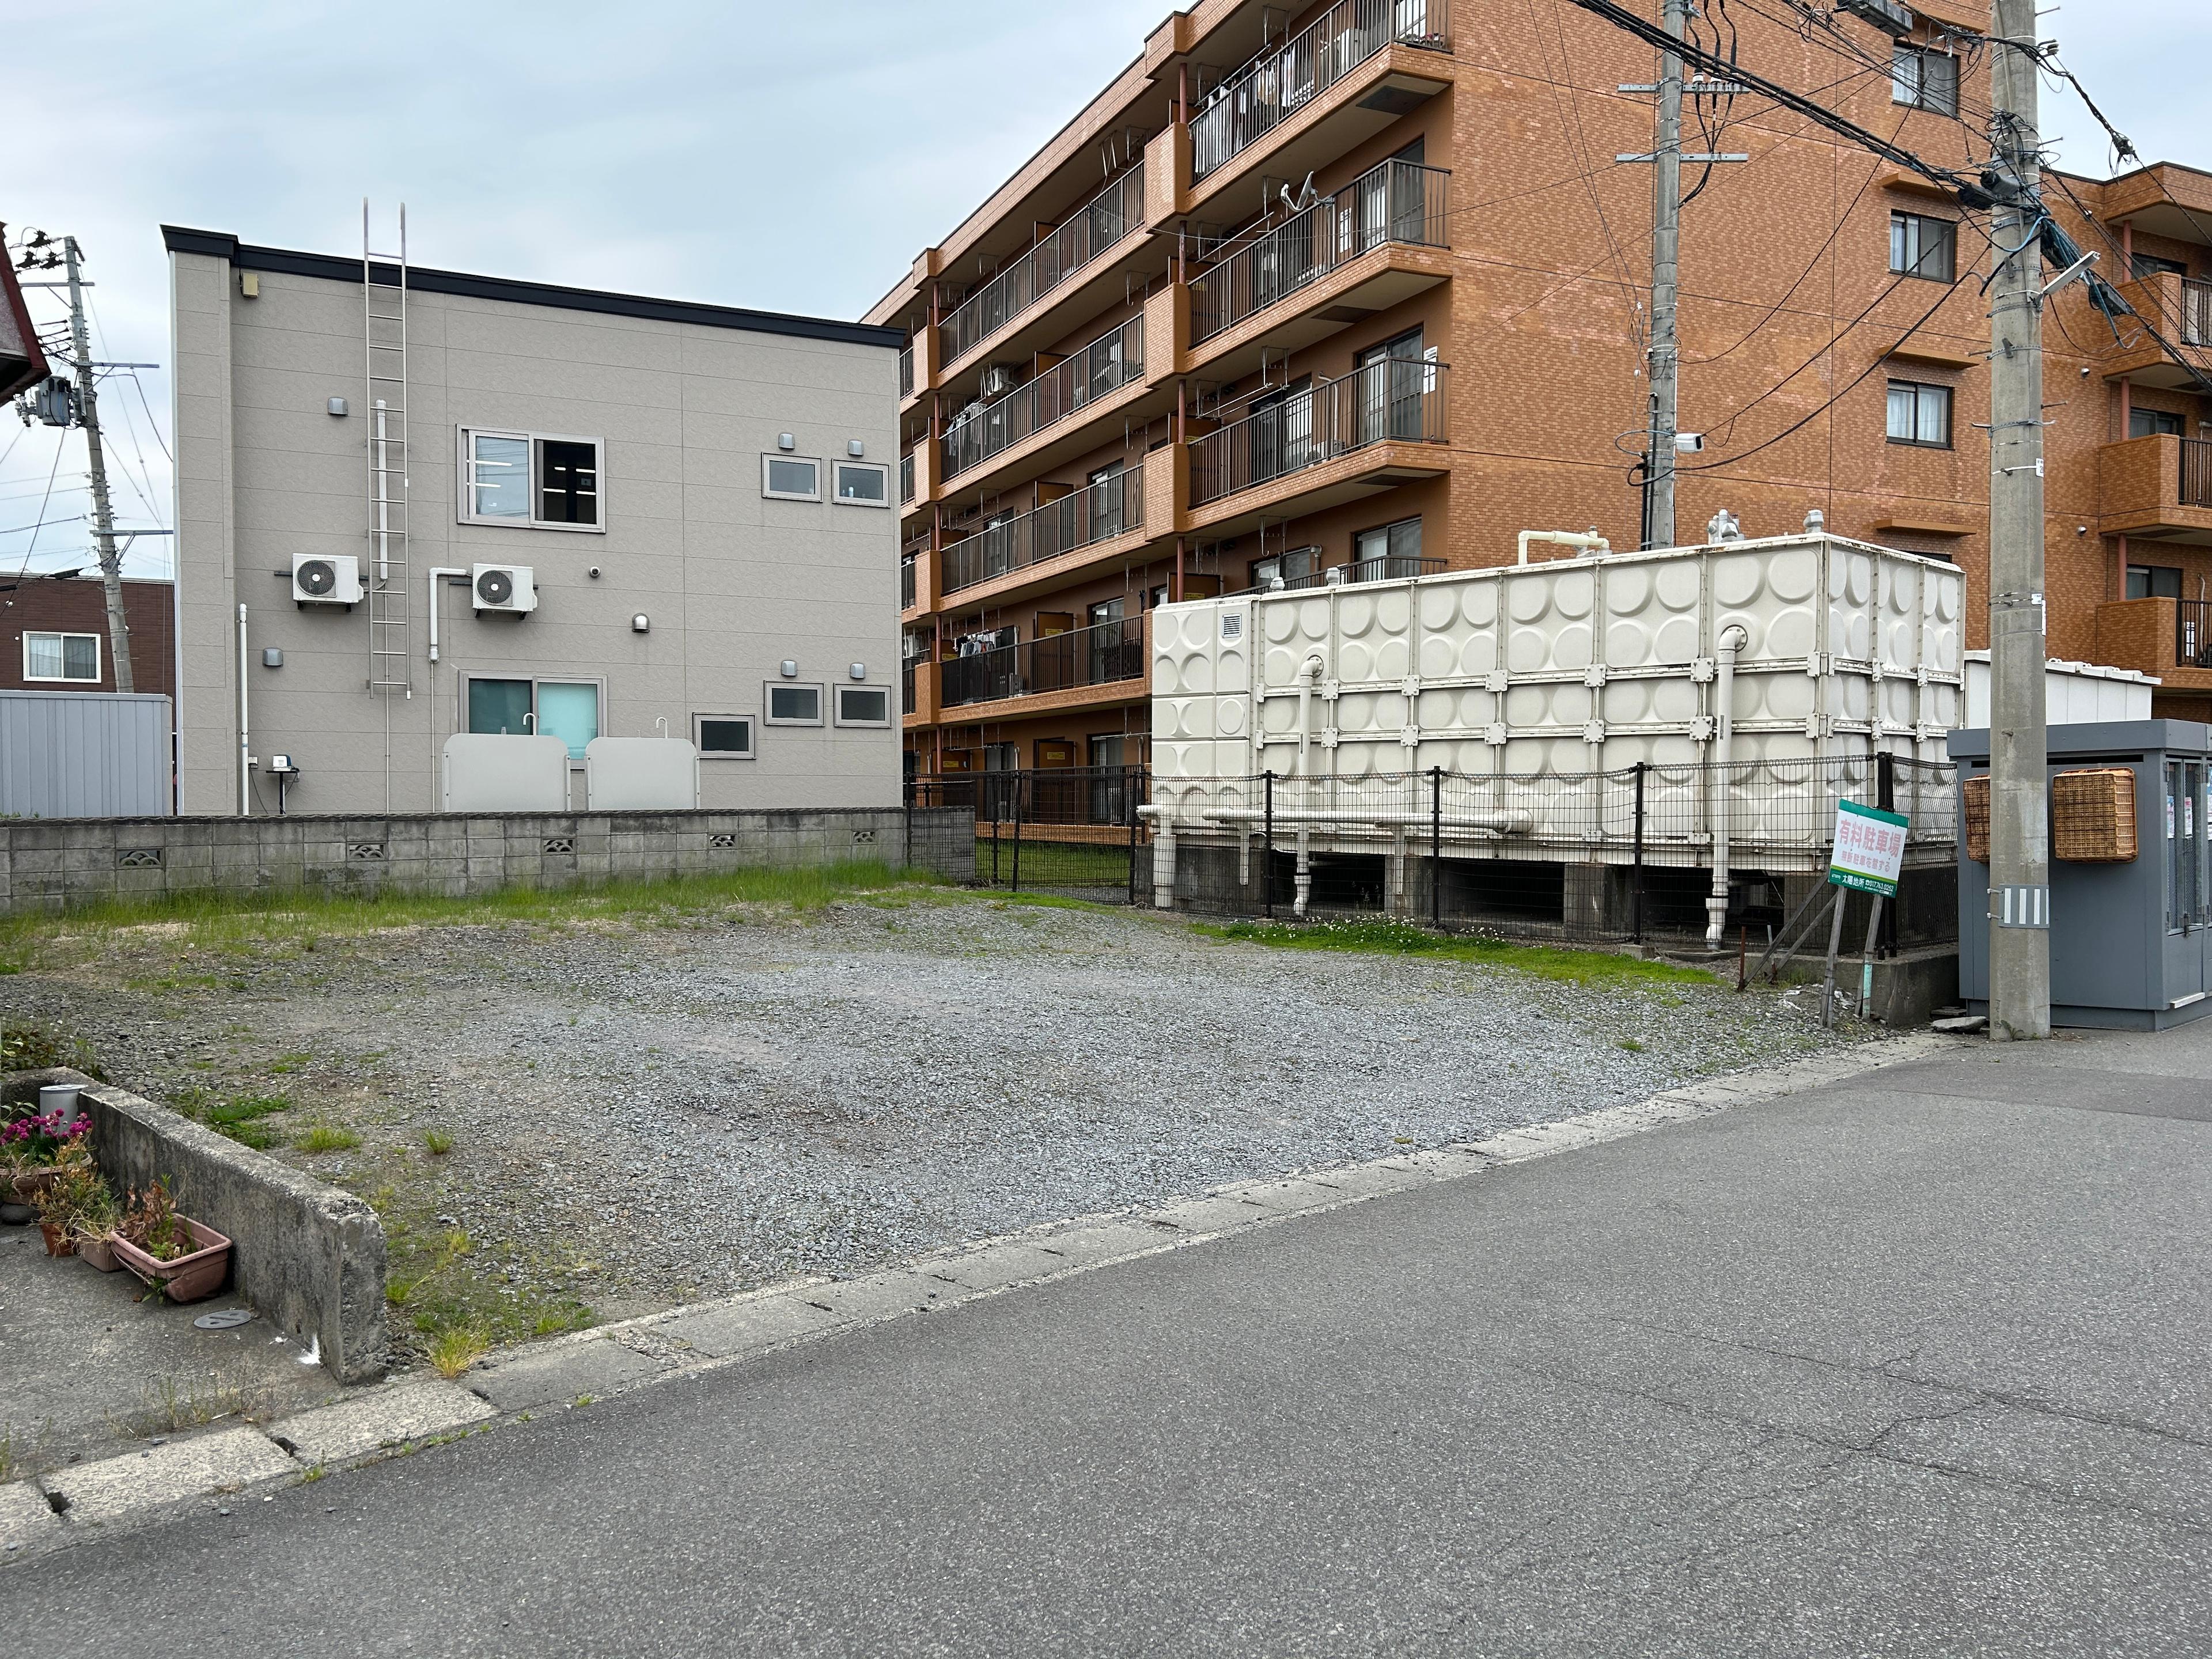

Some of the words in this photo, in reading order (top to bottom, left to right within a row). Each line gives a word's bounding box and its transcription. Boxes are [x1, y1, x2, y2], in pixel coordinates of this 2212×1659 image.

[1840, 819, 1901, 858] 有料駐車場
